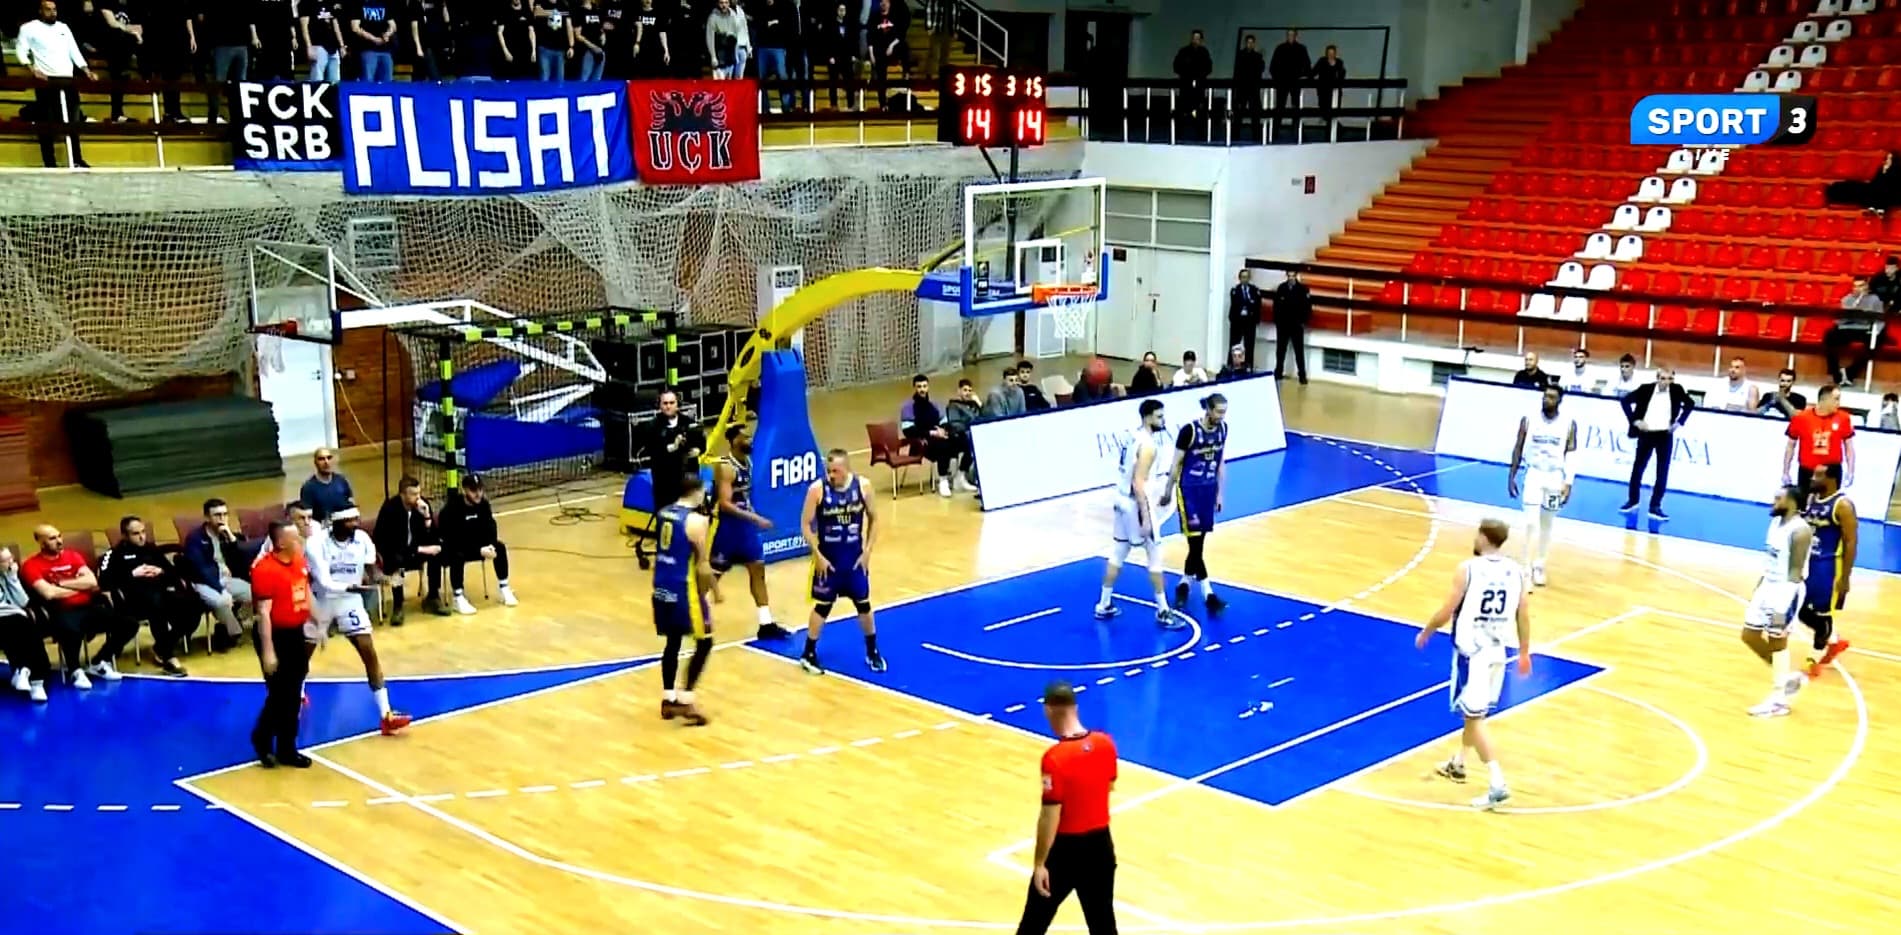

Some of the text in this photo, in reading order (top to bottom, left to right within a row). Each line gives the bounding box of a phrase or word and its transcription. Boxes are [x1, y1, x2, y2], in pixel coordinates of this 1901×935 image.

[240, 82, 333, 119] FCK
[349, 92, 616, 188] PLISAT
[967, 108, 991, 140] 14
[1018, 109, 1042, 141] 14
[243, 123, 331, 160] SRB
[648, 130, 732, 174] UÇK
[771, 451, 817, 489] FIBA
[660, 521, 673, 550] 0
[348, 611, 360, 626] 5
[1480, 589, 1507, 614] 23
